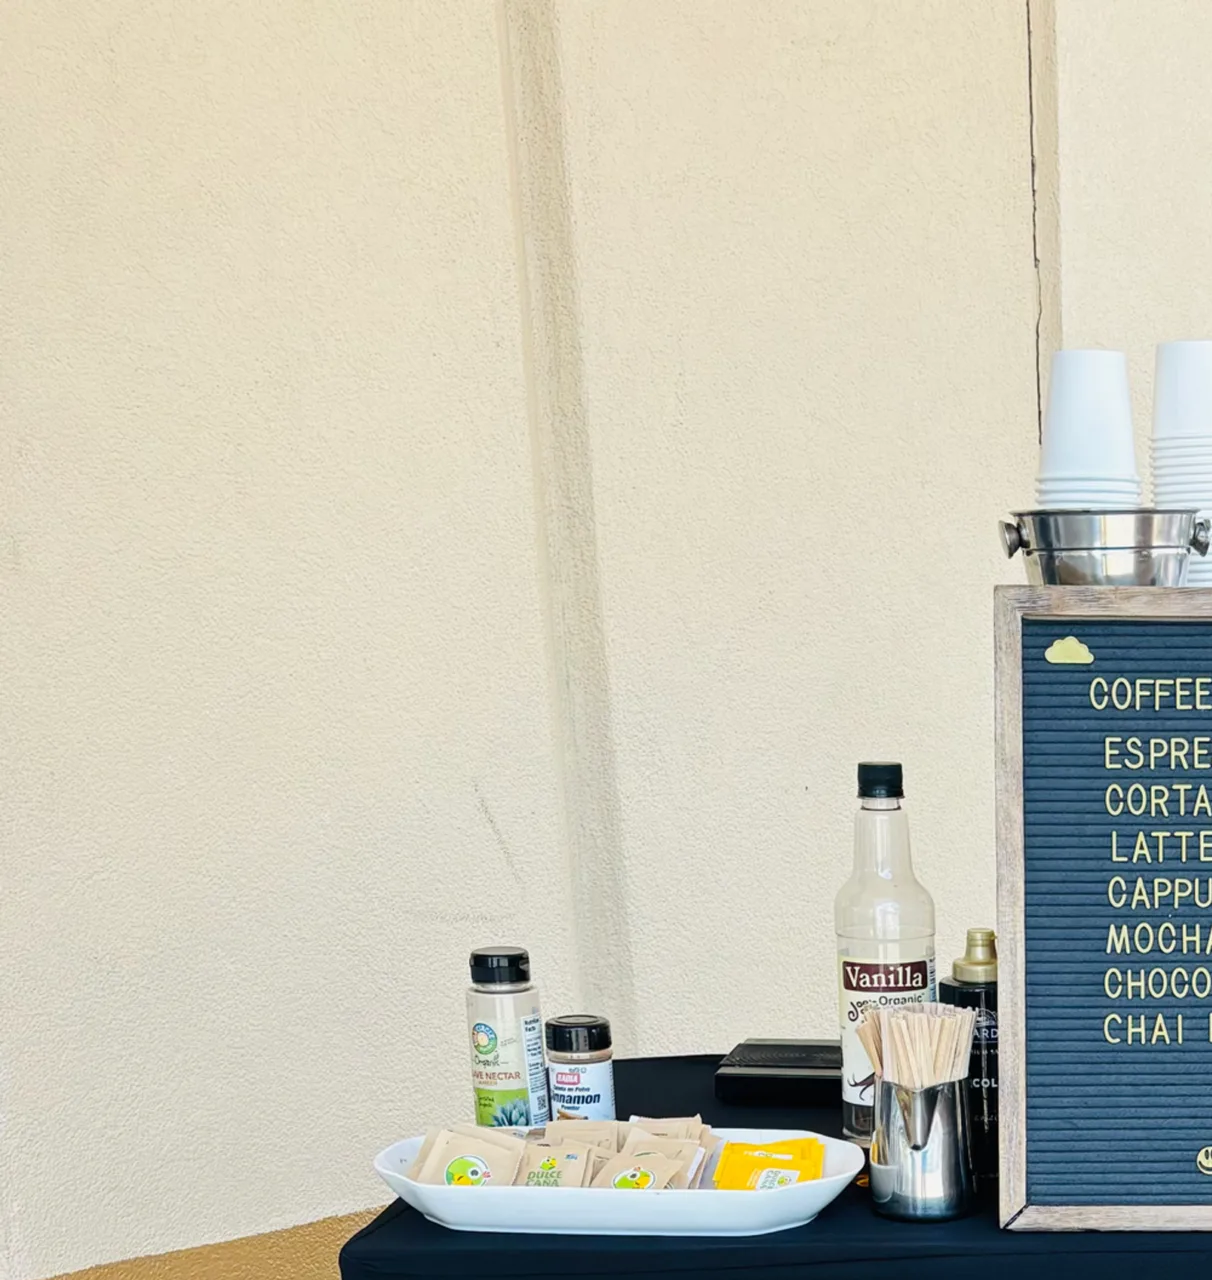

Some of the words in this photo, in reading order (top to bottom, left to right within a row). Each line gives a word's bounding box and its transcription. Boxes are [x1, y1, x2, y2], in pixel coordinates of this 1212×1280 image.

[1089, 677, 1212, 711] COFFEE
[845, 966, 923, 988] Vanilla
[1103, 1013, 1183, 1045] CHAI
[485, 1072, 521, 1080] NECTAR
[527, 1171, 563, 1179] DULCE
